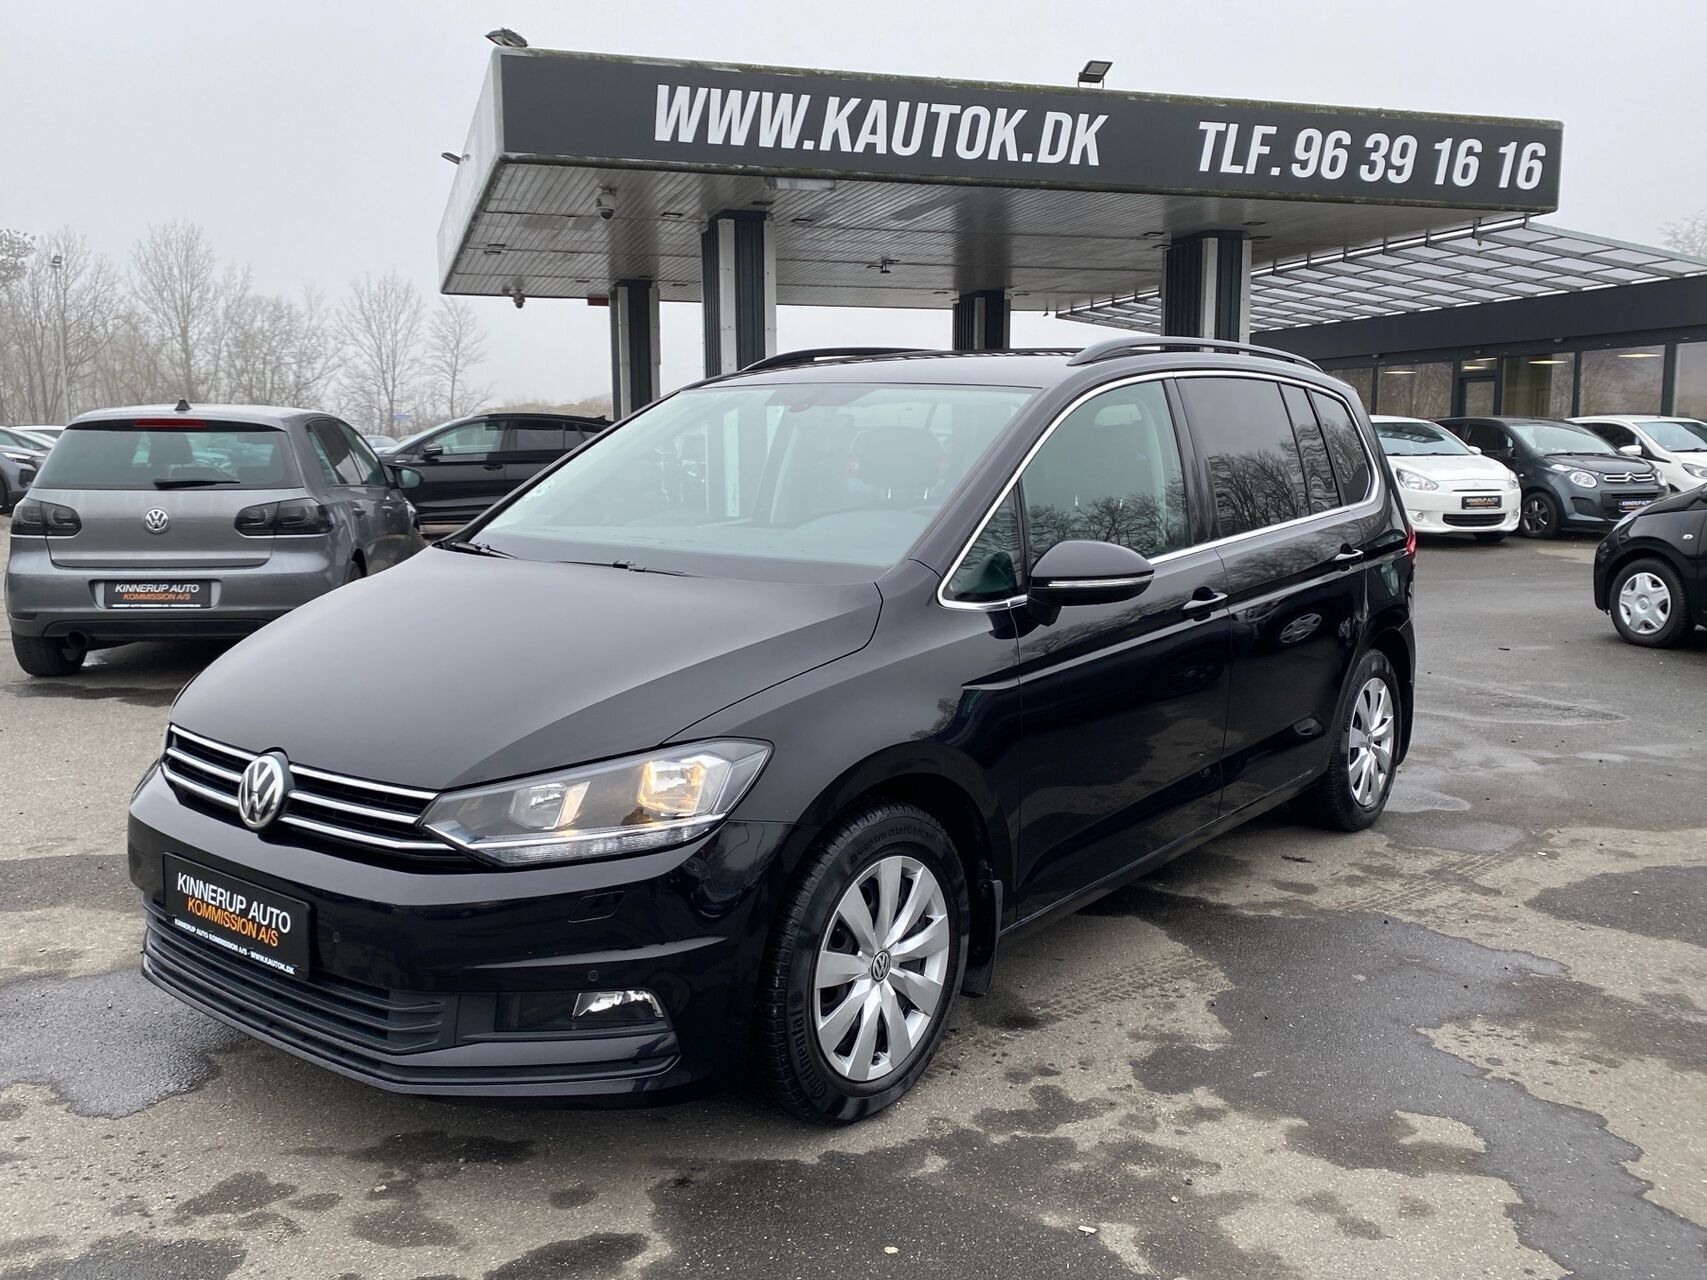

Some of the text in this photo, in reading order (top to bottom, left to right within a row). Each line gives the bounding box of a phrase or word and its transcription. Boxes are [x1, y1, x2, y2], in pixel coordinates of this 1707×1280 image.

[654, 84, 1109, 167] WWW.KAUTOK.DK
[1198, 120, 1548, 191] TLF. 96 39 16 16
[115, 583, 200, 593] KINNERUP AUTO
[123, 593, 191, 601] KOMMISSION A/S
[177, 872, 291, 934] KINNERUP AUTO
[187, 897, 279, 947] KOMMISSION A/S
[196, 928, 209, 940] AUTO
[790, 1008, 827, 1100] Continental
